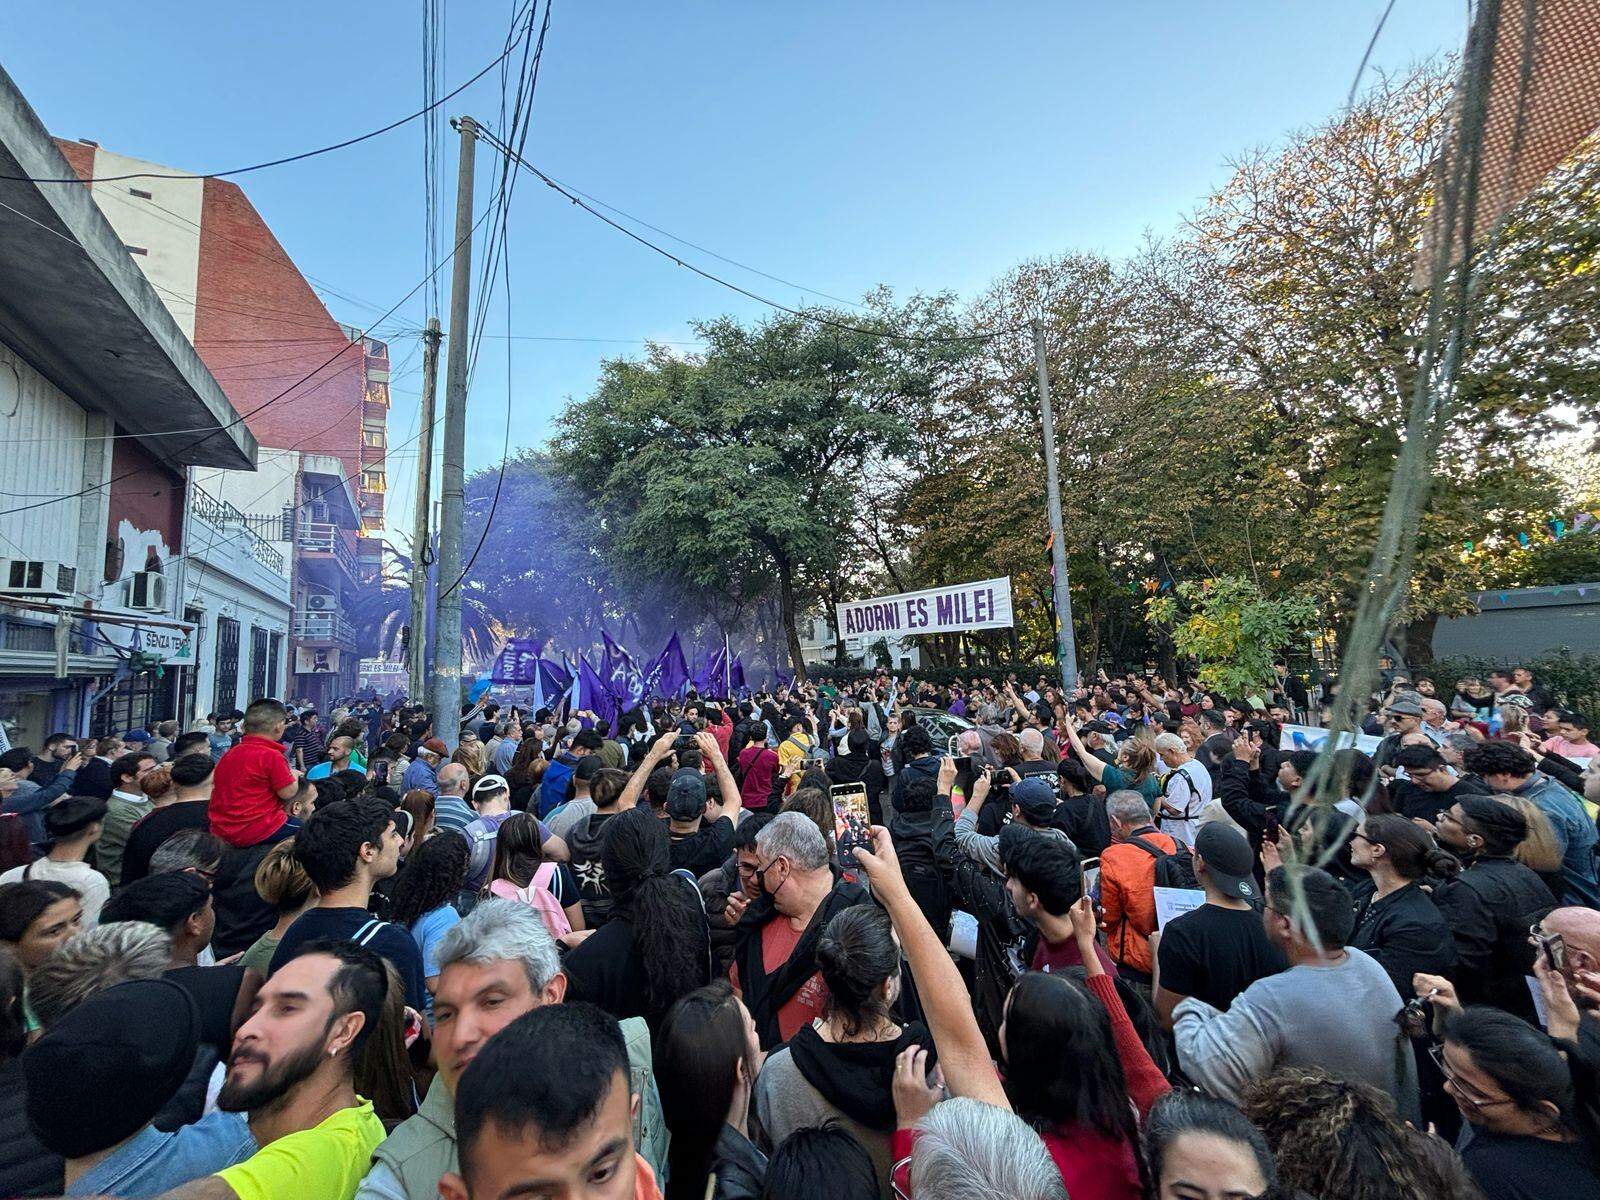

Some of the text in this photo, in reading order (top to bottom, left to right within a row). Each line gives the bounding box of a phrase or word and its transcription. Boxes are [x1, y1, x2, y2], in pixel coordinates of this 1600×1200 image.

[846, 589, 994, 633] ADORNI ES MILEI
[146, 633, 169, 649] SENZA
